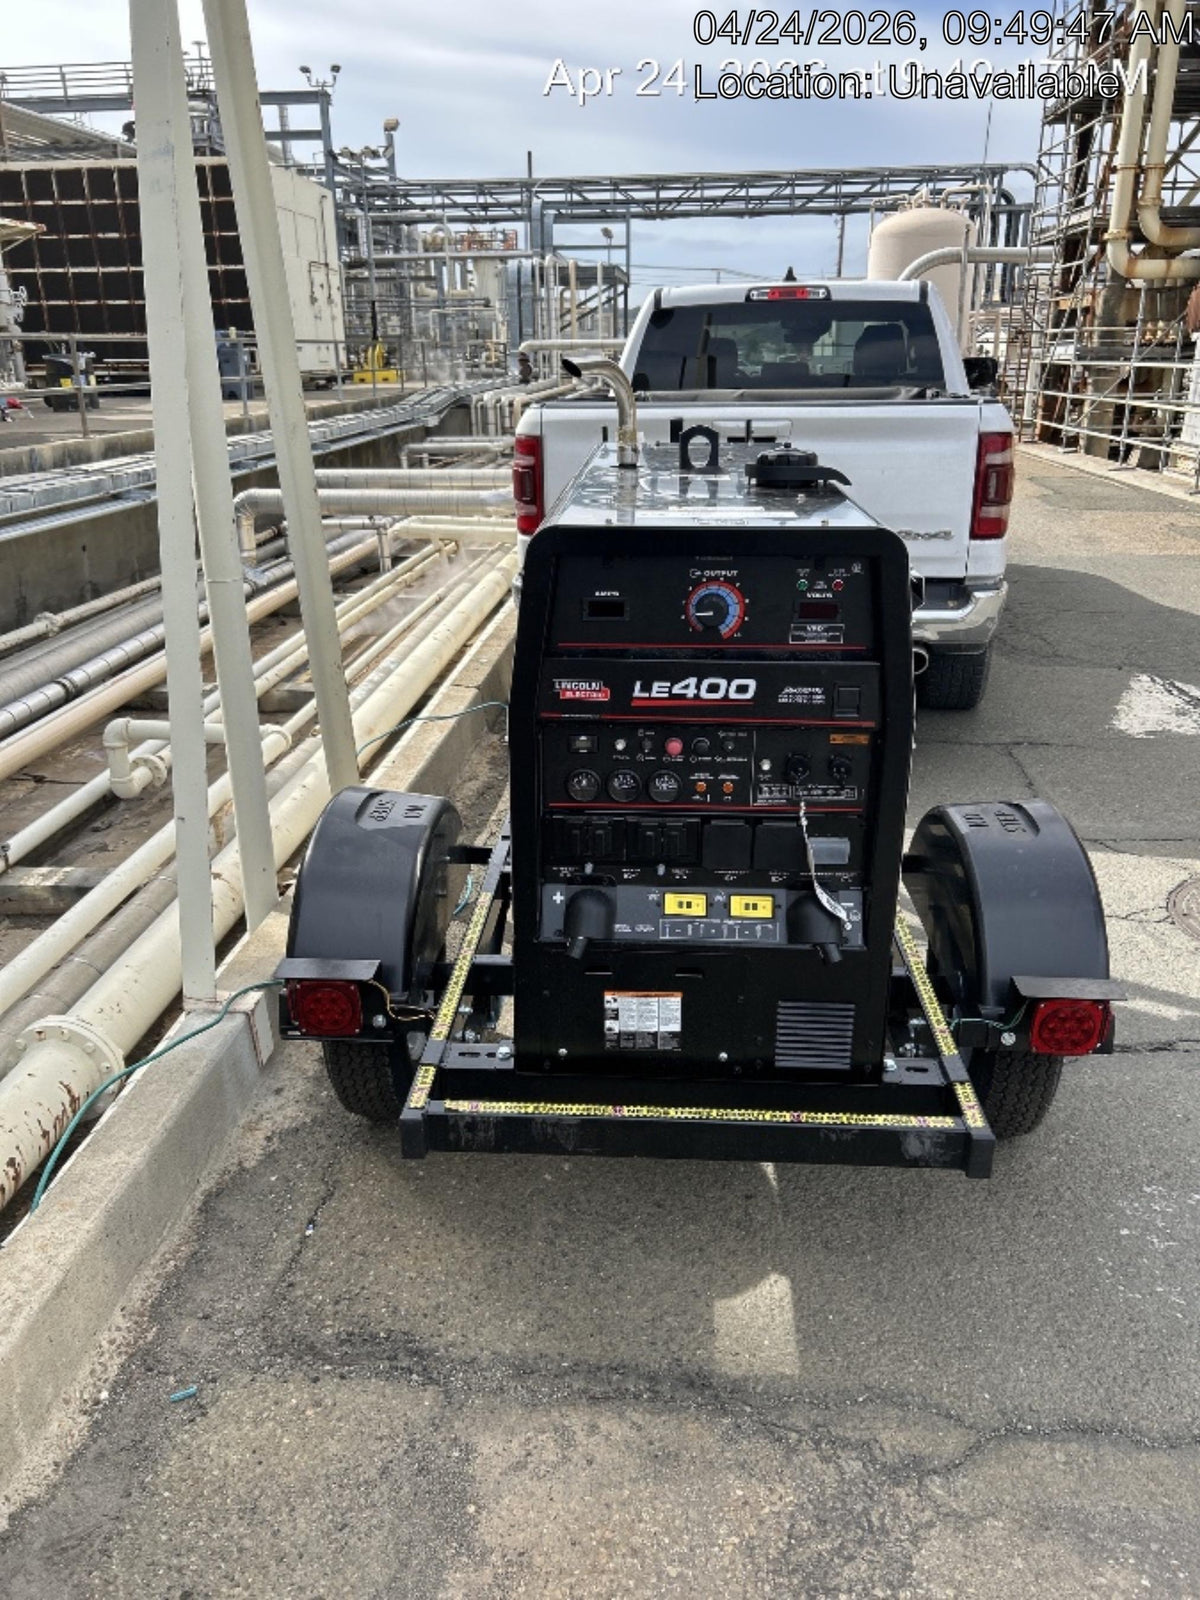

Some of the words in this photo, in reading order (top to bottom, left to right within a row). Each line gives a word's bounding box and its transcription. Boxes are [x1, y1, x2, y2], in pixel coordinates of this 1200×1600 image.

[703, 569, 739, 577] OUTPUT
[554, 680, 602, 691] LINCOLN
[632, 677, 757, 700] LE400
[994, 809, 1027, 833] STEP
